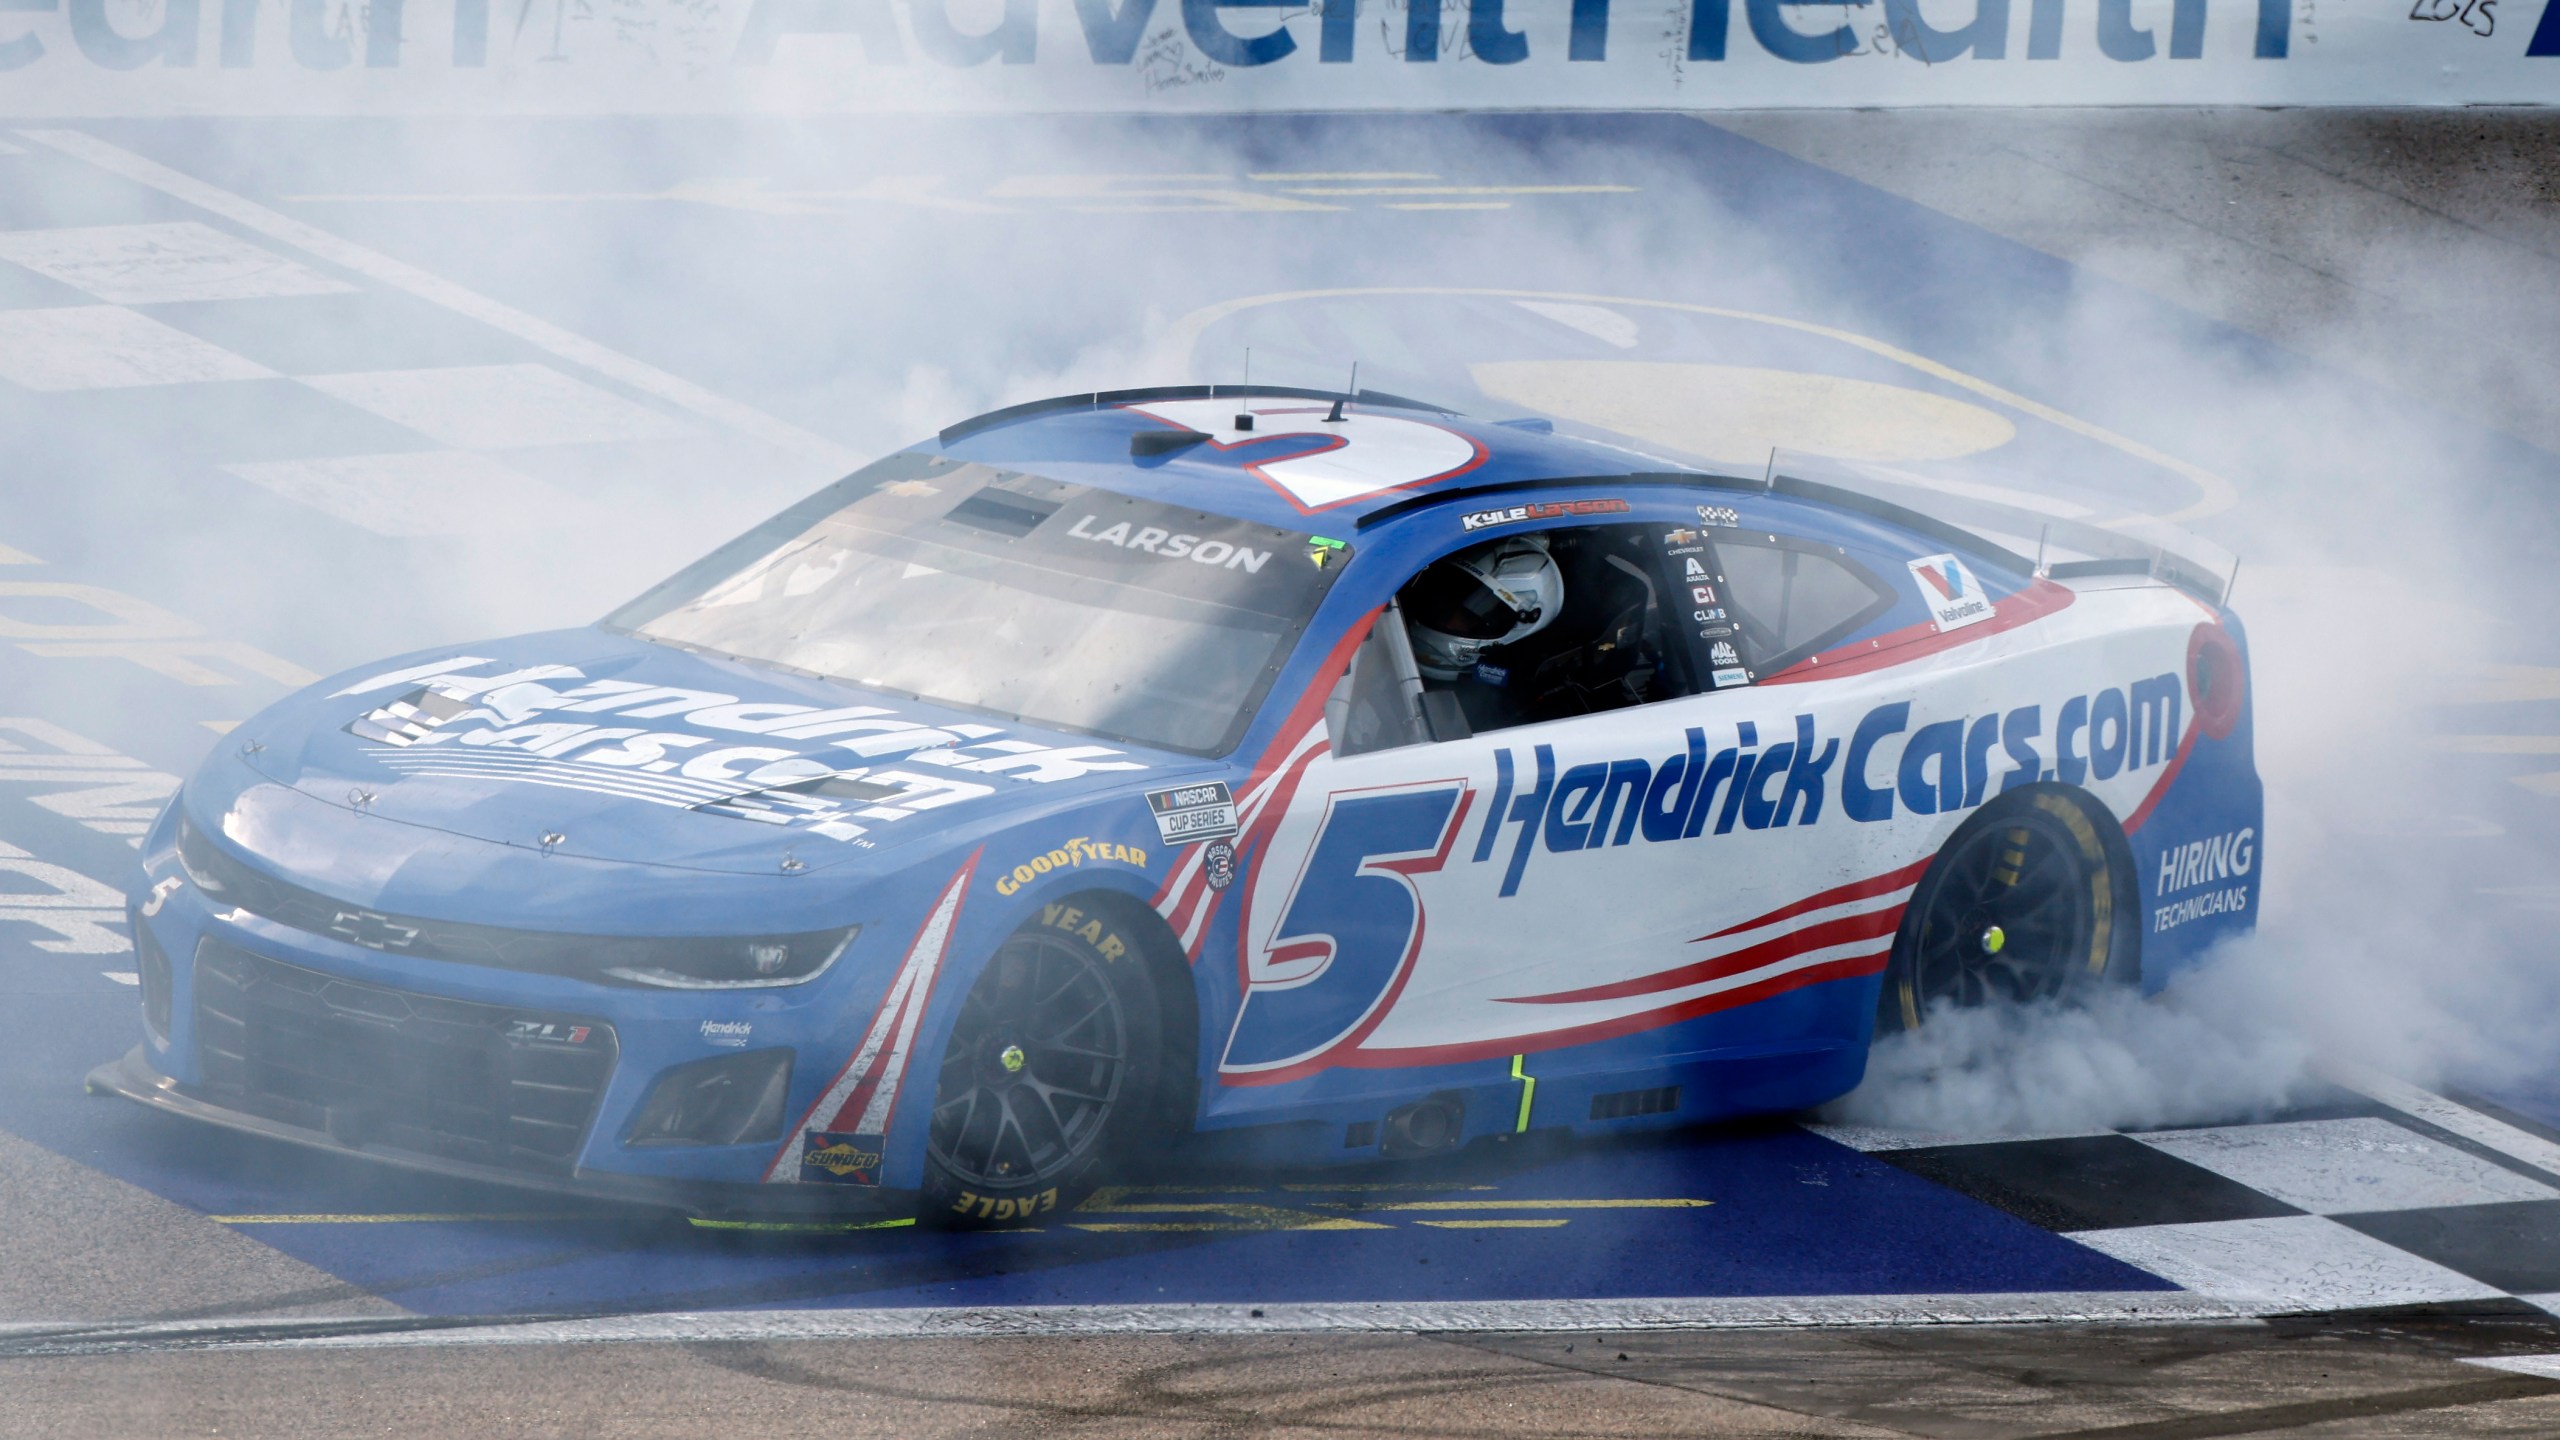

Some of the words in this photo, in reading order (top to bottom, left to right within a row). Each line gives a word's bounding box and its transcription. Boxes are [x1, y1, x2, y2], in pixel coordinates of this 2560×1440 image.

[1067, 514, 1273, 575] LARSON
[1667, 546, 1704, 556] CHEVROLET
[1686, 574, 1711, 583] AXALTA
[1937, 601, 1985, 623] Valvoline
[1713, 658, 1739, 666] TOOLS
[1717, 672, 1745, 682] SIEMENS
[1174, 786, 1218, 807] NASCAR
[1169, 813, 1189, 832] CUP
[1191, 809, 1225, 829] SERIES
[1207, 845, 1233, 862] NASCAR
[2157, 827, 2255, 897] HIRING
[996, 838, 1148, 896] GOODYEAR
[2154, 885, 2247, 933] TECHNICIANS
[1041, 903, 1126, 964] YEAR
[1220, 778, 1468, 1075] 5
[505, 1020, 592, 1044] ZL1
[700, 1019, 752, 1036] Hendrick
[808, 1151, 879, 1169] SUNOCO
[951, 1187, 1058, 1221] EAGLE
